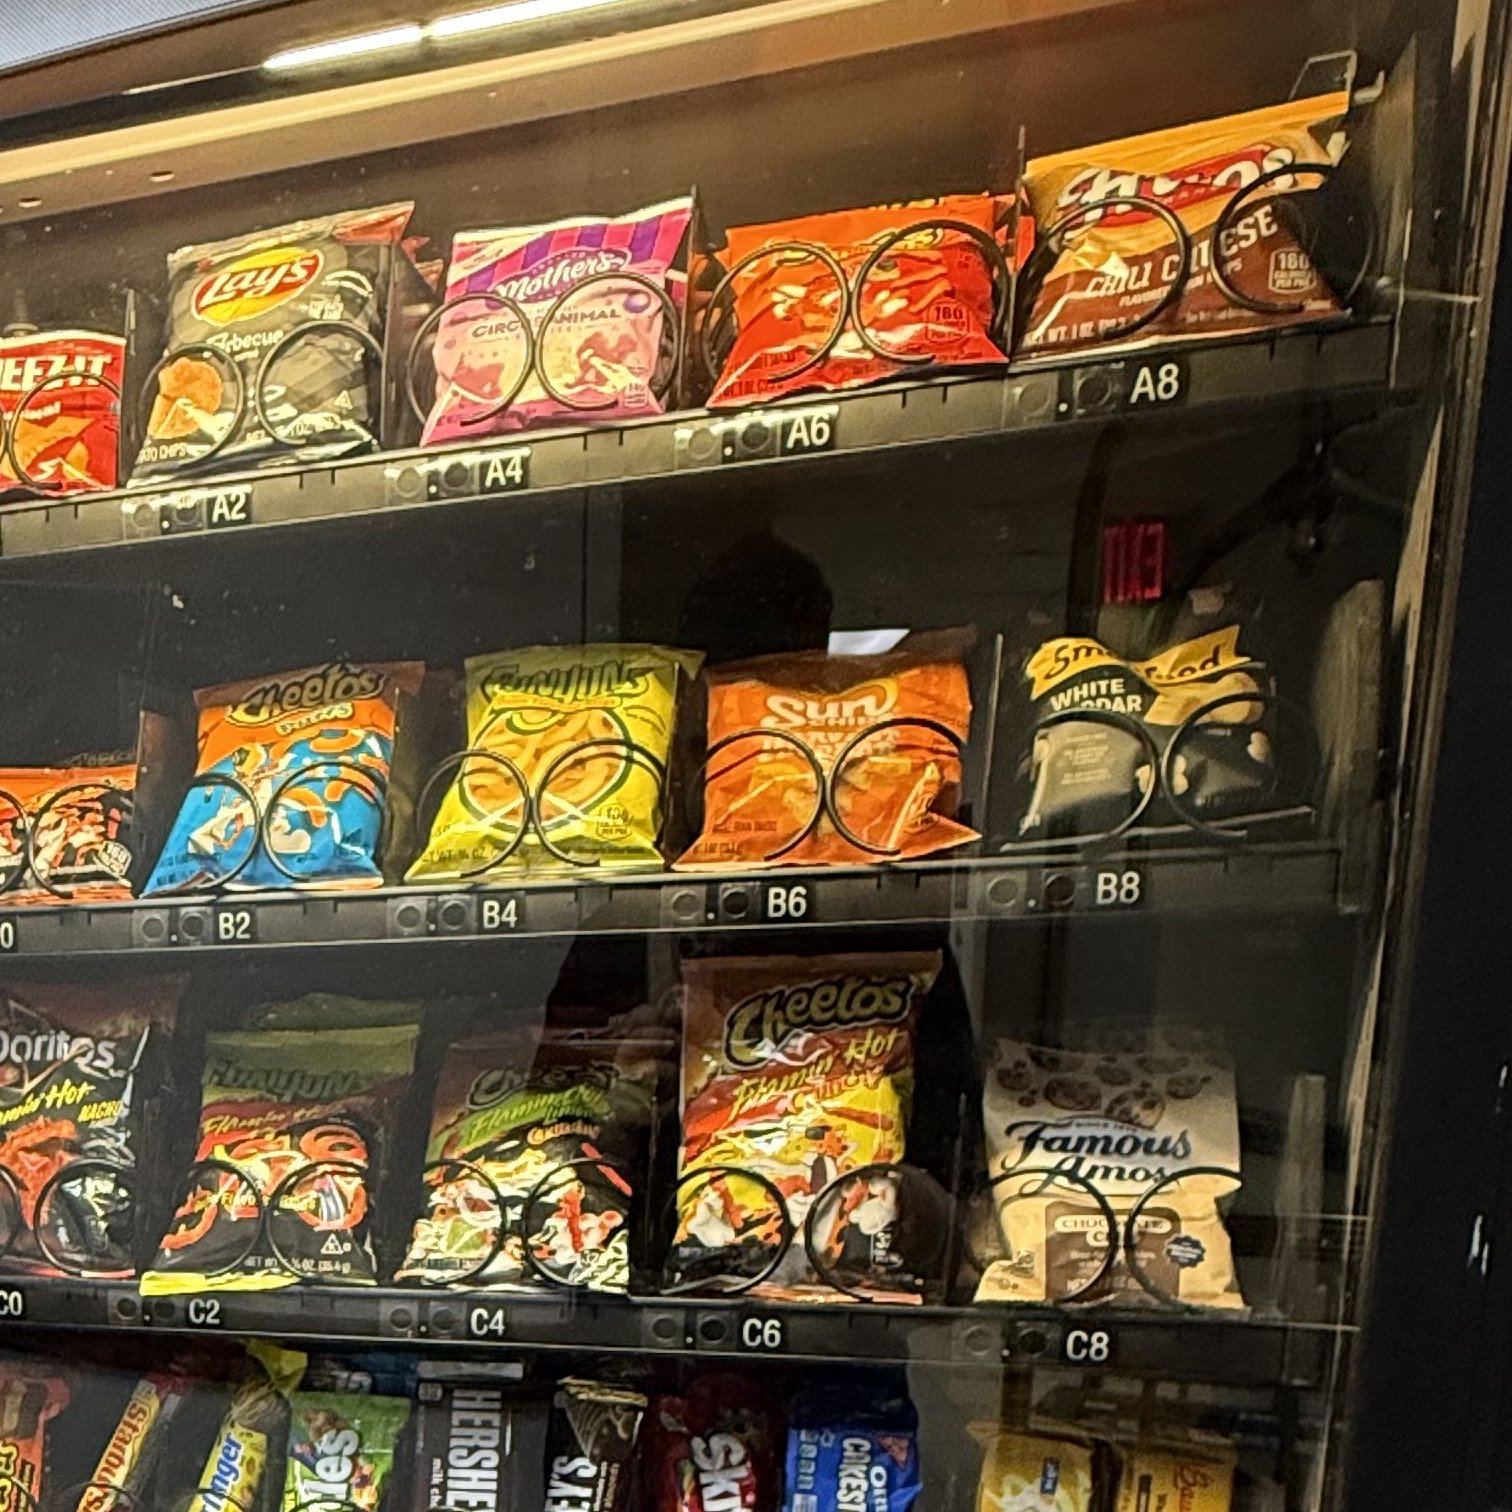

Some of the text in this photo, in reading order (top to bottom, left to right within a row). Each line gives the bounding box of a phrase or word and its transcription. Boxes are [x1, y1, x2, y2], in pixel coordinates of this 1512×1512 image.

[1130, 365, 1178, 404] A8
[788, 416, 829, 446] A6
[485, 455, 522, 486] A4
[211, 495, 247, 522] A2
[761, 680, 898, 728] Sun
[1051, 678, 1125, 710] WHITE
[1097, 872, 1140, 904] B8
[482, 900, 517, 929] B4
[768, 889, 807, 918] B6
[218, 912, 251, 940] B2
[728, 976, 908, 1062] Cheetos
[46, 1079, 95, 1109] Hot
[1001, 1120, 1191, 1171] Famous
[1018, 1156, 1168, 1197] Amos
[190, 1300, 220, 1325] C2
[471, 1309, 505, 1335] C4
[743, 1319, 781, 1347] C6
[1066, 1330, 1109, 1361] C8
